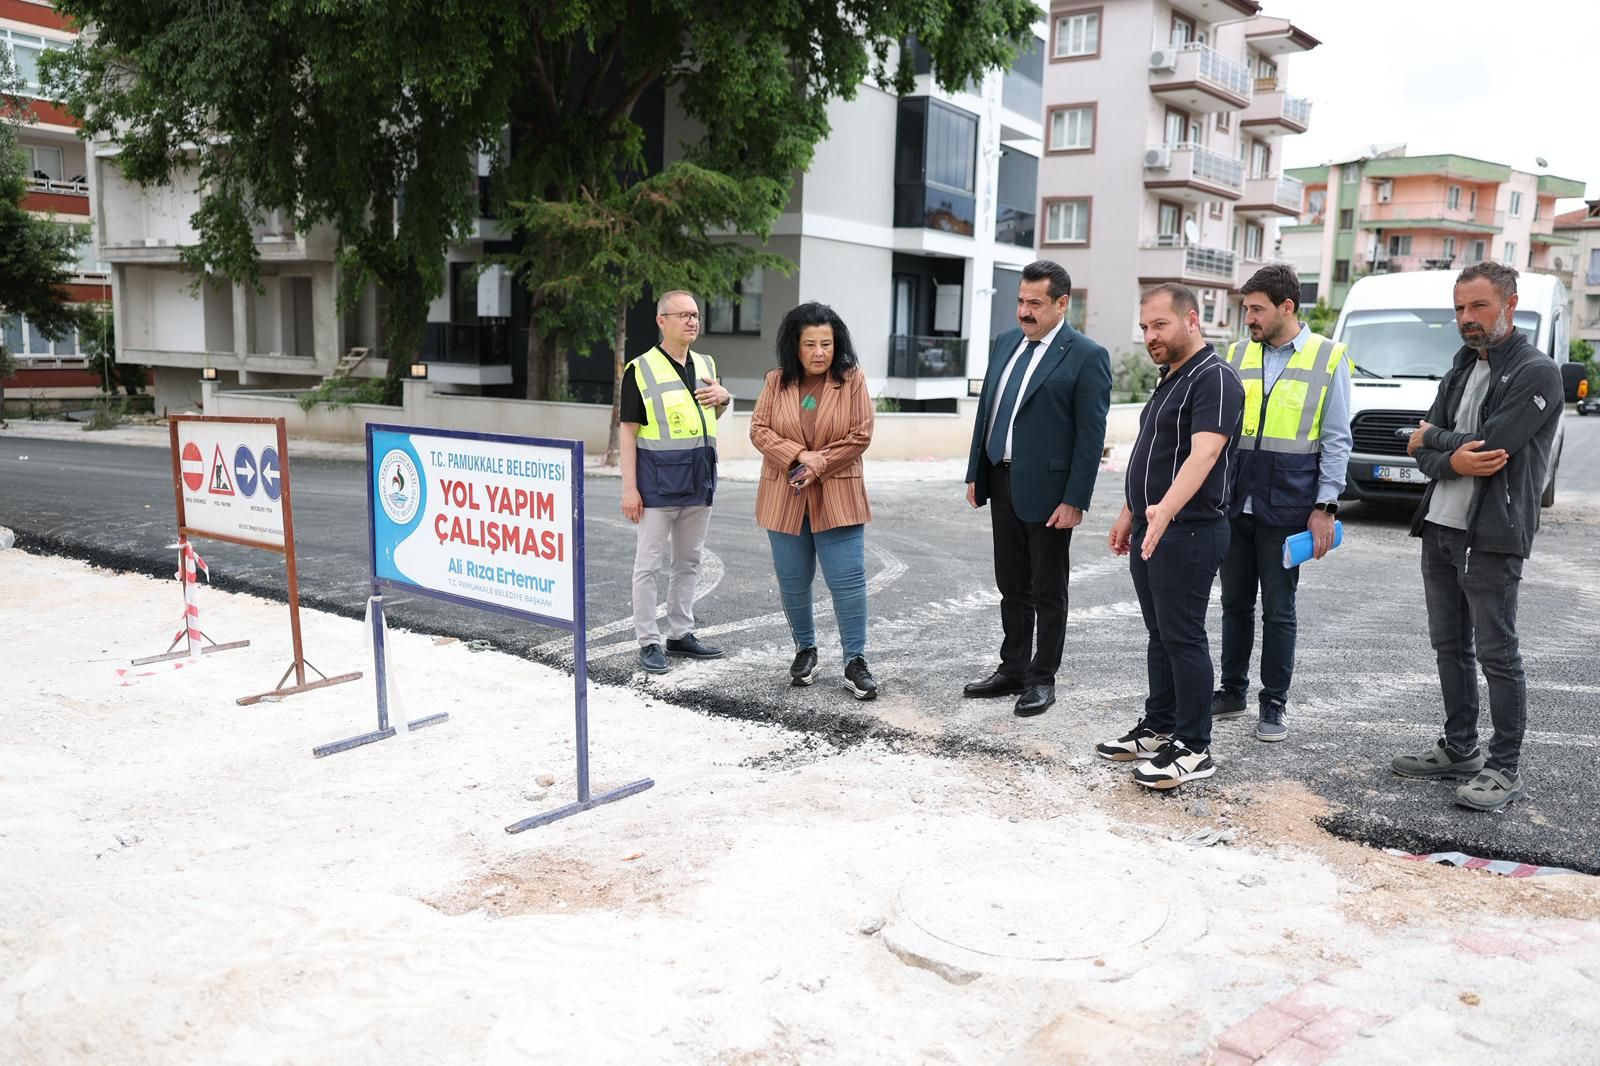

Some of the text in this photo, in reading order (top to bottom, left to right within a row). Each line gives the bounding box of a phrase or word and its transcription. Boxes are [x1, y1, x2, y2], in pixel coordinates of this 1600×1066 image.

[430, 451, 565, 481] T.C. PAMUKKALE BELEDİYESİ
[1378, 467, 1411, 479] 20 BS
[439, 478, 554, 522] YOL YAPIM
[434, 513, 564, 562] ÇALIŞMASI
[448, 557, 556, 594] Ali Rıza Ertemur
[458, 580, 494, 595] PAMUKKALE
[524, 595, 553, 608] BAŞKANI
